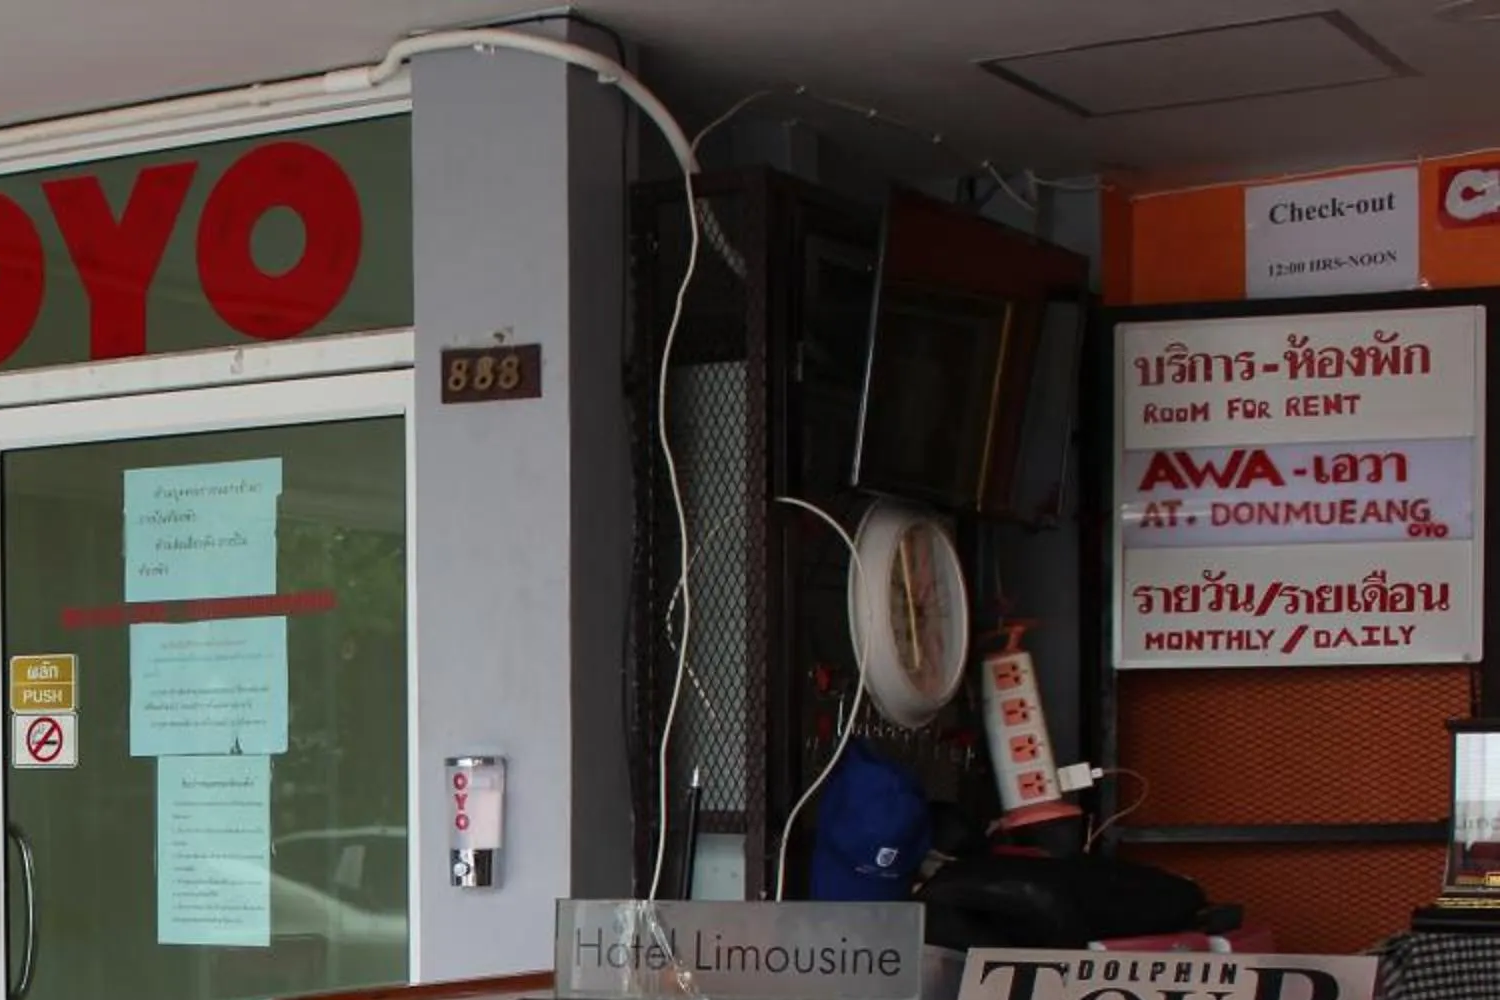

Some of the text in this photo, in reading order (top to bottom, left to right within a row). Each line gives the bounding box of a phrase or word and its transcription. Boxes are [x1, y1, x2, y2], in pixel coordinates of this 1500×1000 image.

[1268, 191, 1396, 225] Check-out
[1268, 260, 1306, 278] 12:00
[1227, 398, 1272, 420] FOR
[1285, 394, 1361, 418] RENT
[1210, 498, 1432, 526] DONMUEANG
[1407, 523, 1449, 538] OYO
[23, 689, 63, 704] PUSH
[453, 772, 470, 830] OYO
[575, 927, 902, 977] Hotel Limousine
[1077, 959, 1238, 985] DOLPHIN
